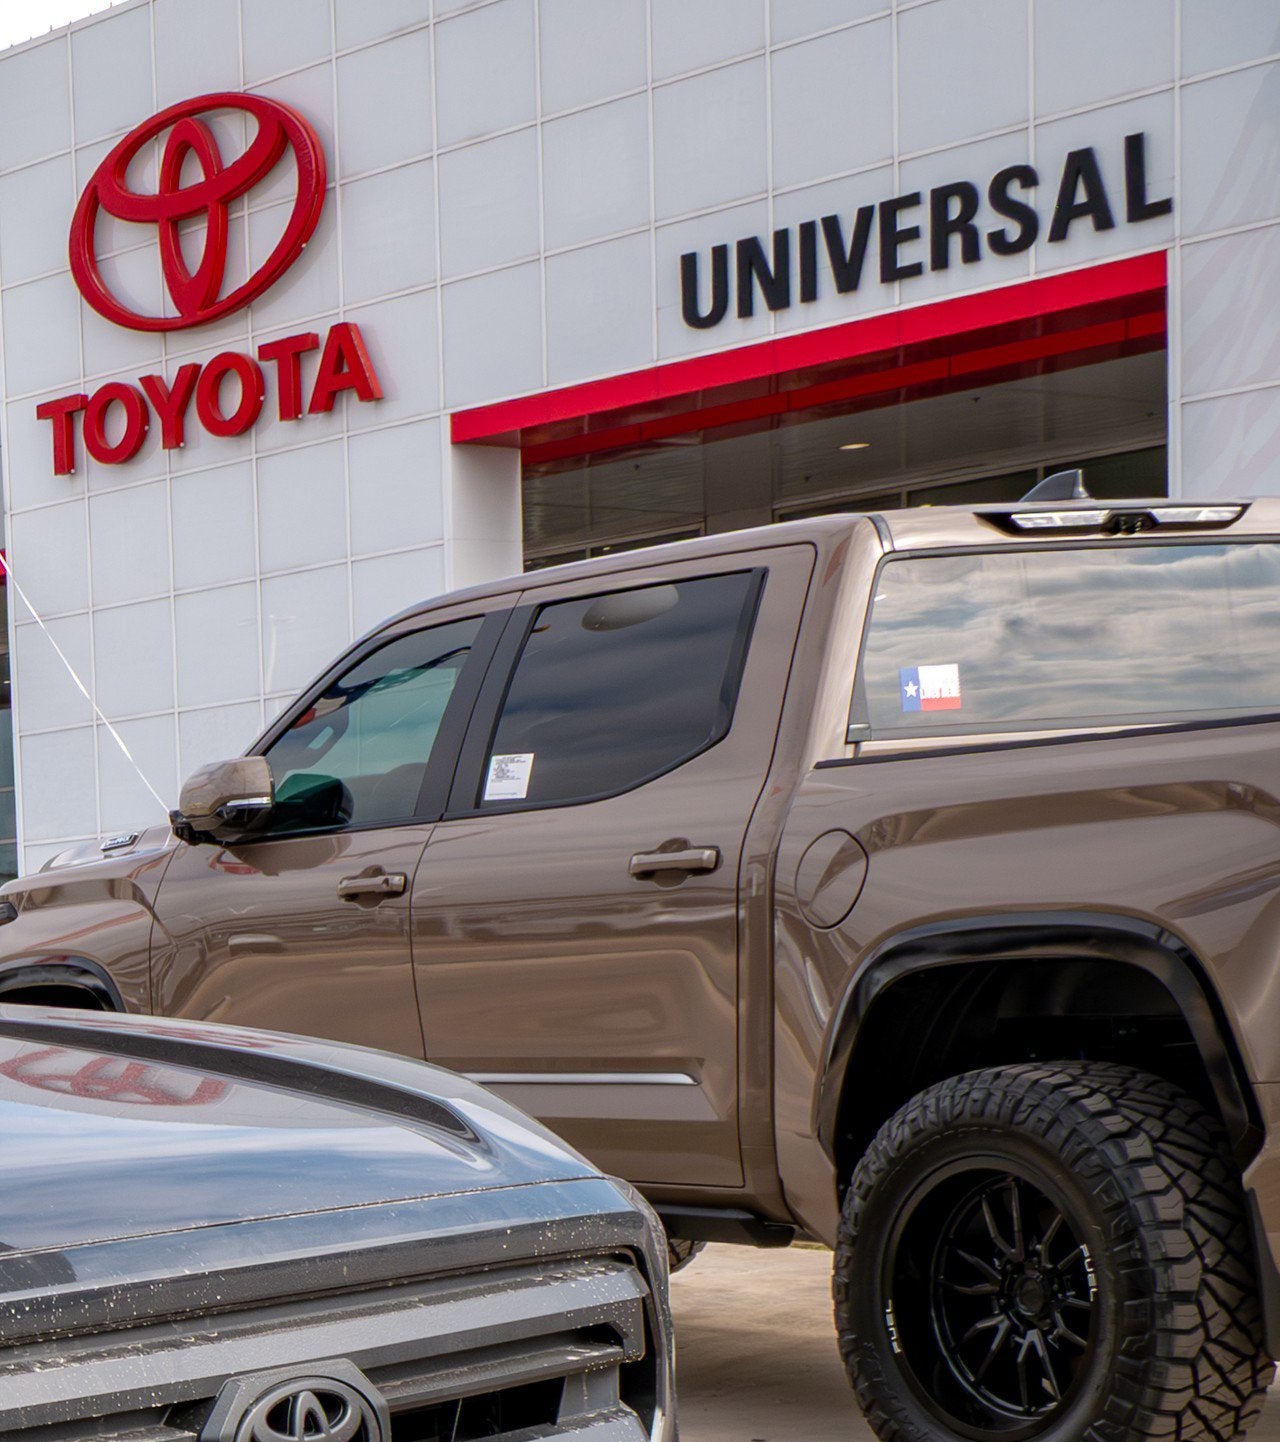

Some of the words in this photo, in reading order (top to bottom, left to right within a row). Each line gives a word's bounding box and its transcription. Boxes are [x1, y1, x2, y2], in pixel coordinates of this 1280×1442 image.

[680, 132, 1174, 329] UNIVERSAL
[37, 322, 385, 475] TOYOTA
[1080, 1243, 1099, 1302] FUEL
[885, 1299, 901, 1354] FUEL
